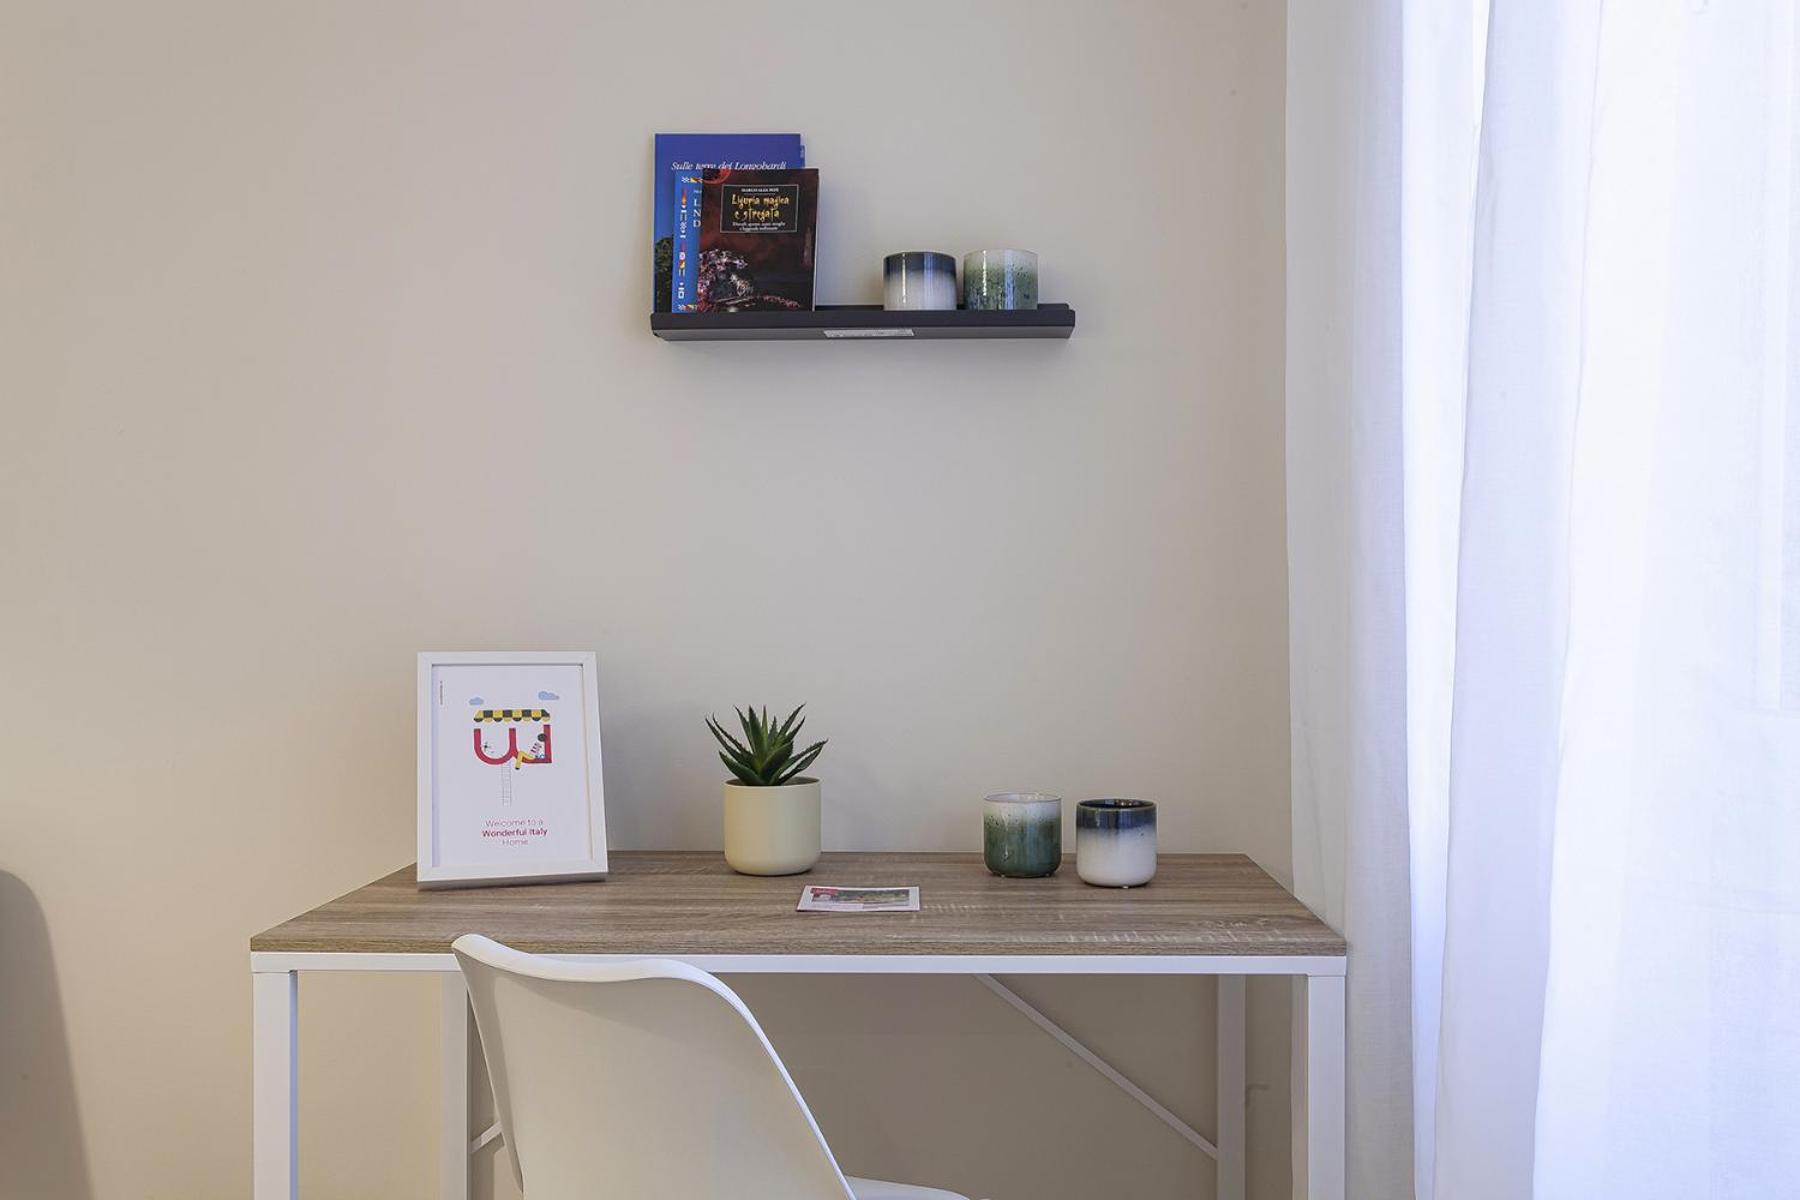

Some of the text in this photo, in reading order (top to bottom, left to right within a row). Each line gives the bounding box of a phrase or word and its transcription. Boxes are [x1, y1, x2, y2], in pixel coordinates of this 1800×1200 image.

[671, 161, 693, 170] Sulle
[731, 194, 790, 209] Liguria magica
[743, 208, 780, 222] stregata
[485, 819, 526, 828] Welcome
[527, 818, 537, 826] to
[482, 827, 548, 838] Wonderful Italy
[502, 839, 529, 847] Home
